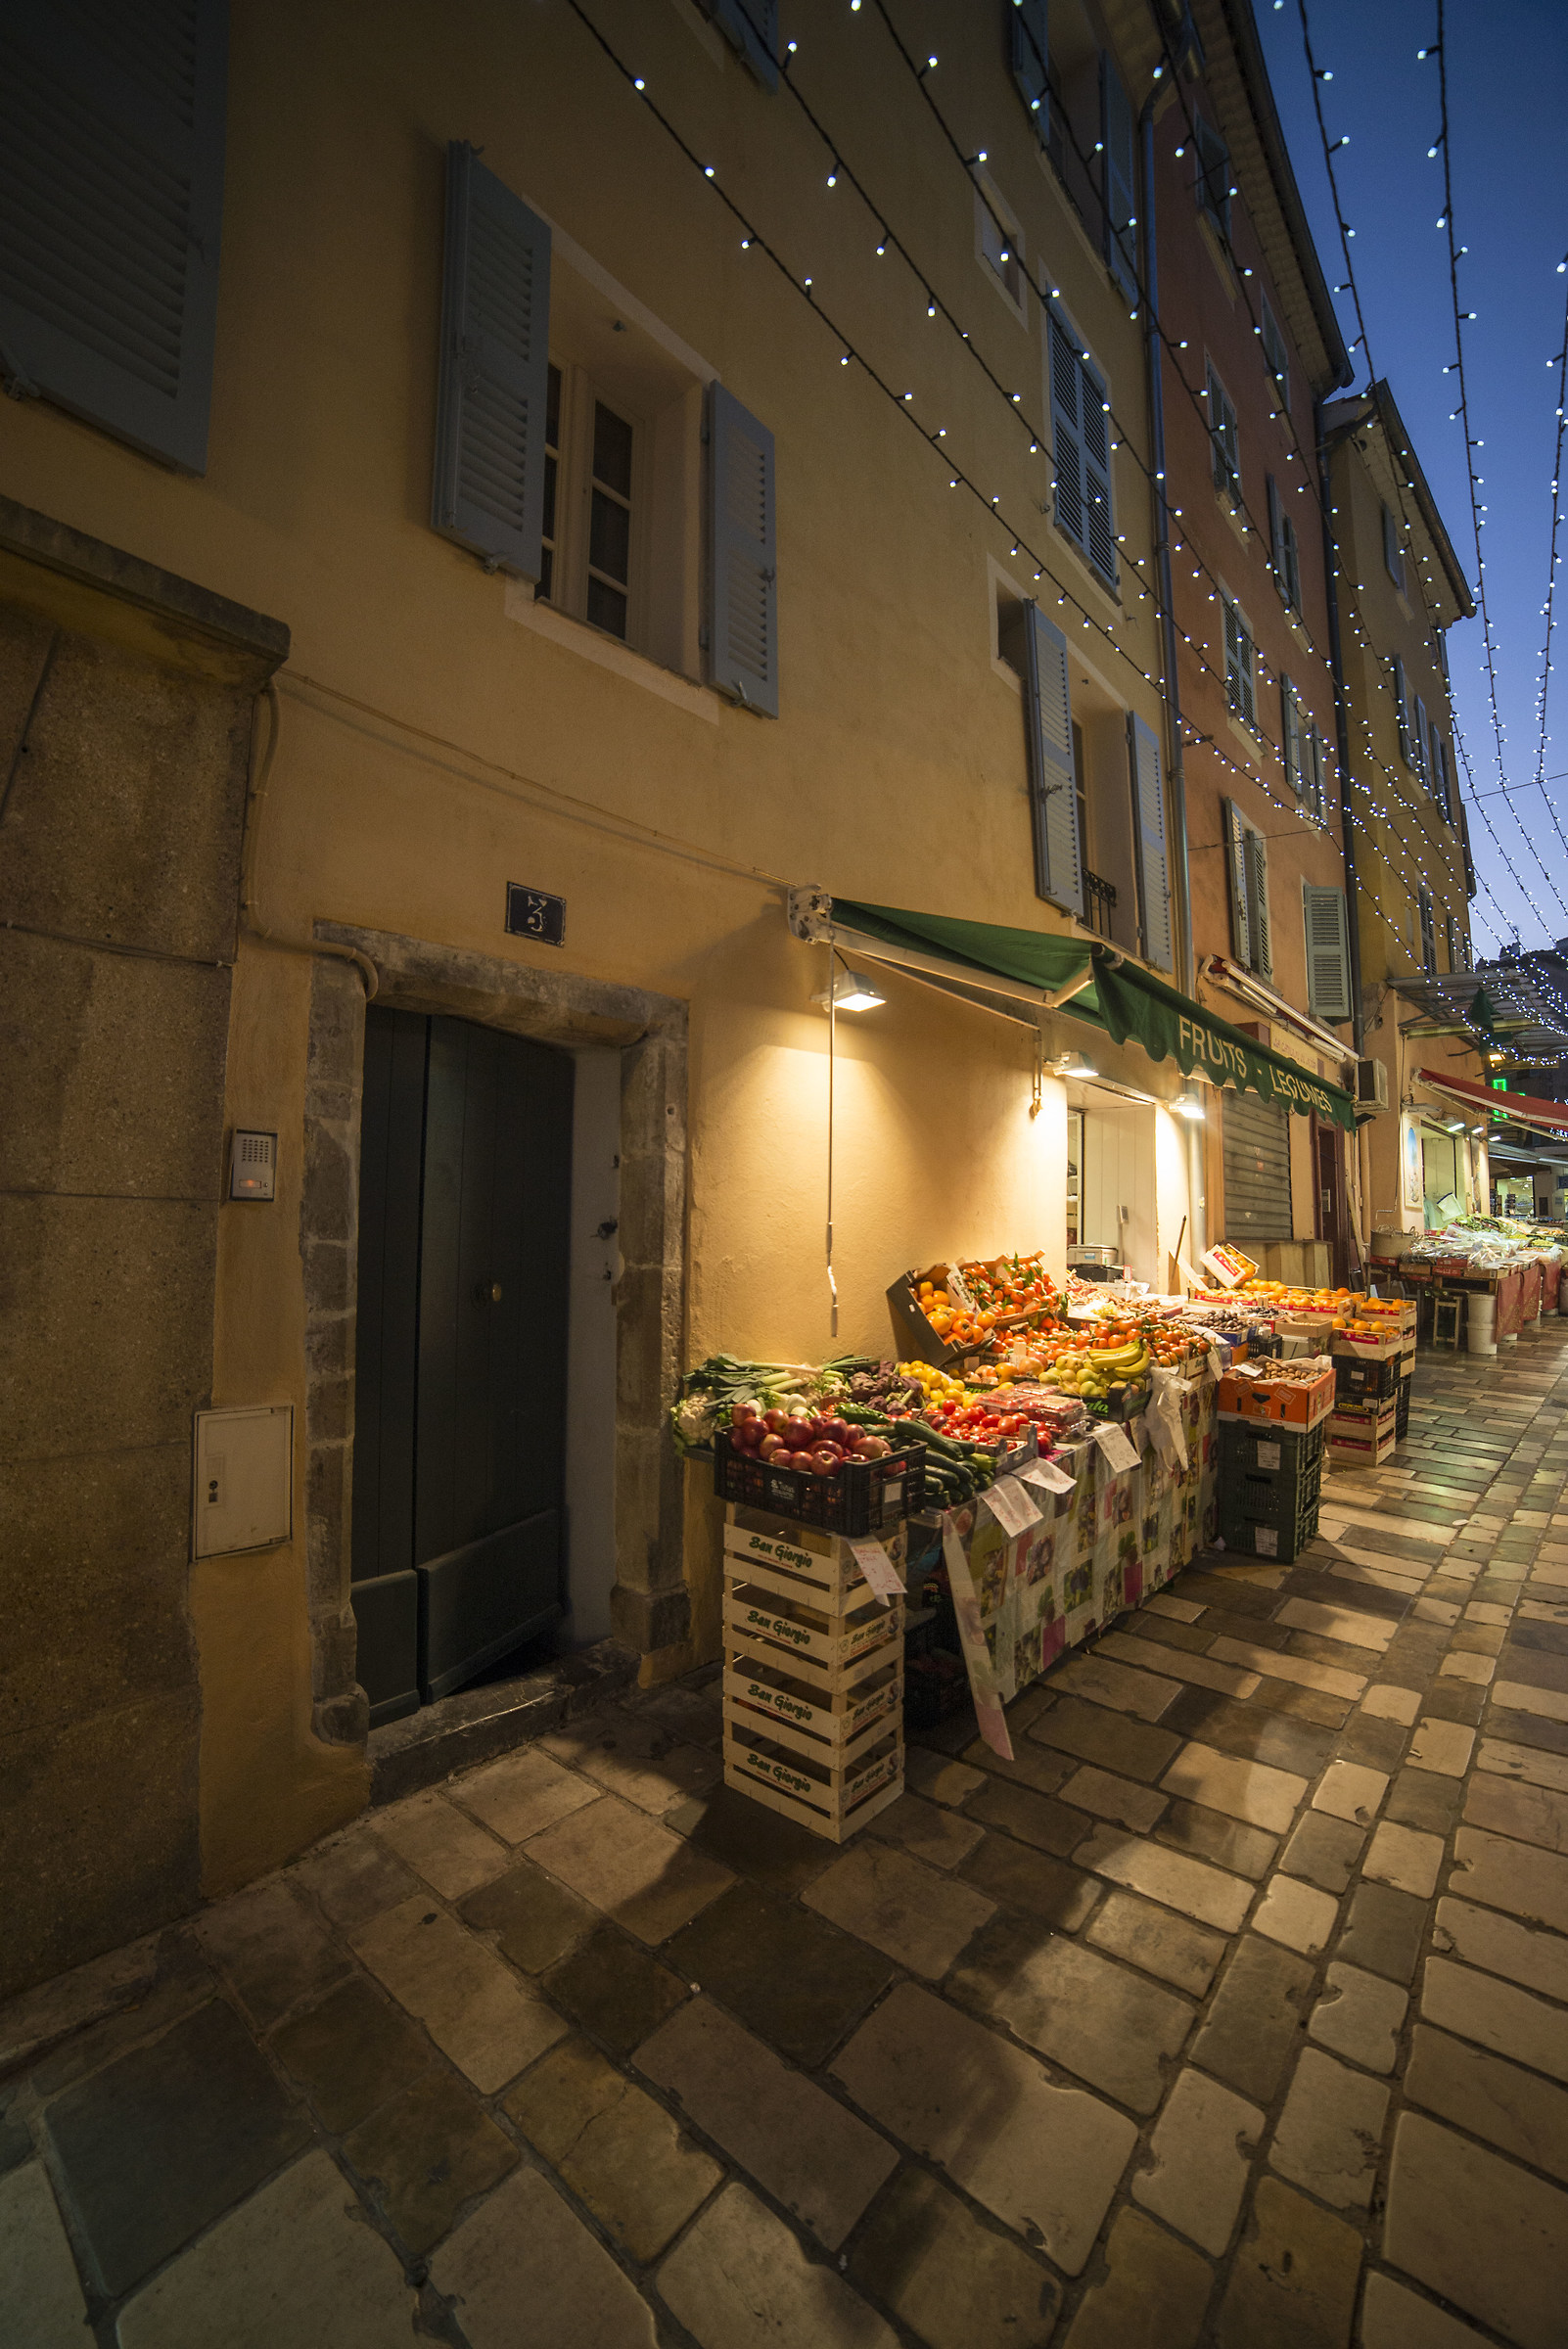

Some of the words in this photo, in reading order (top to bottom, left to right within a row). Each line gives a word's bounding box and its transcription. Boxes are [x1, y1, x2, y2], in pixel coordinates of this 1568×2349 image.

[528, 895, 547, 932] 3
[1178, 1014, 1247, 1079] FRUITS
[1268, 1064, 1333, 1114] LEGUMES
[749, 1536, 773, 1554] San
[774, 1544, 813, 1568] Giorgio
[747, 1610, 770, 1629] San
[772, 1620, 811, 1644] Giorgio
[748, 1683, 772, 1703] San
[774, 1694, 812, 1721] Giorgio
[747, 1753, 770, 1773] San
[772, 1766, 811, 1792] Giorgio
